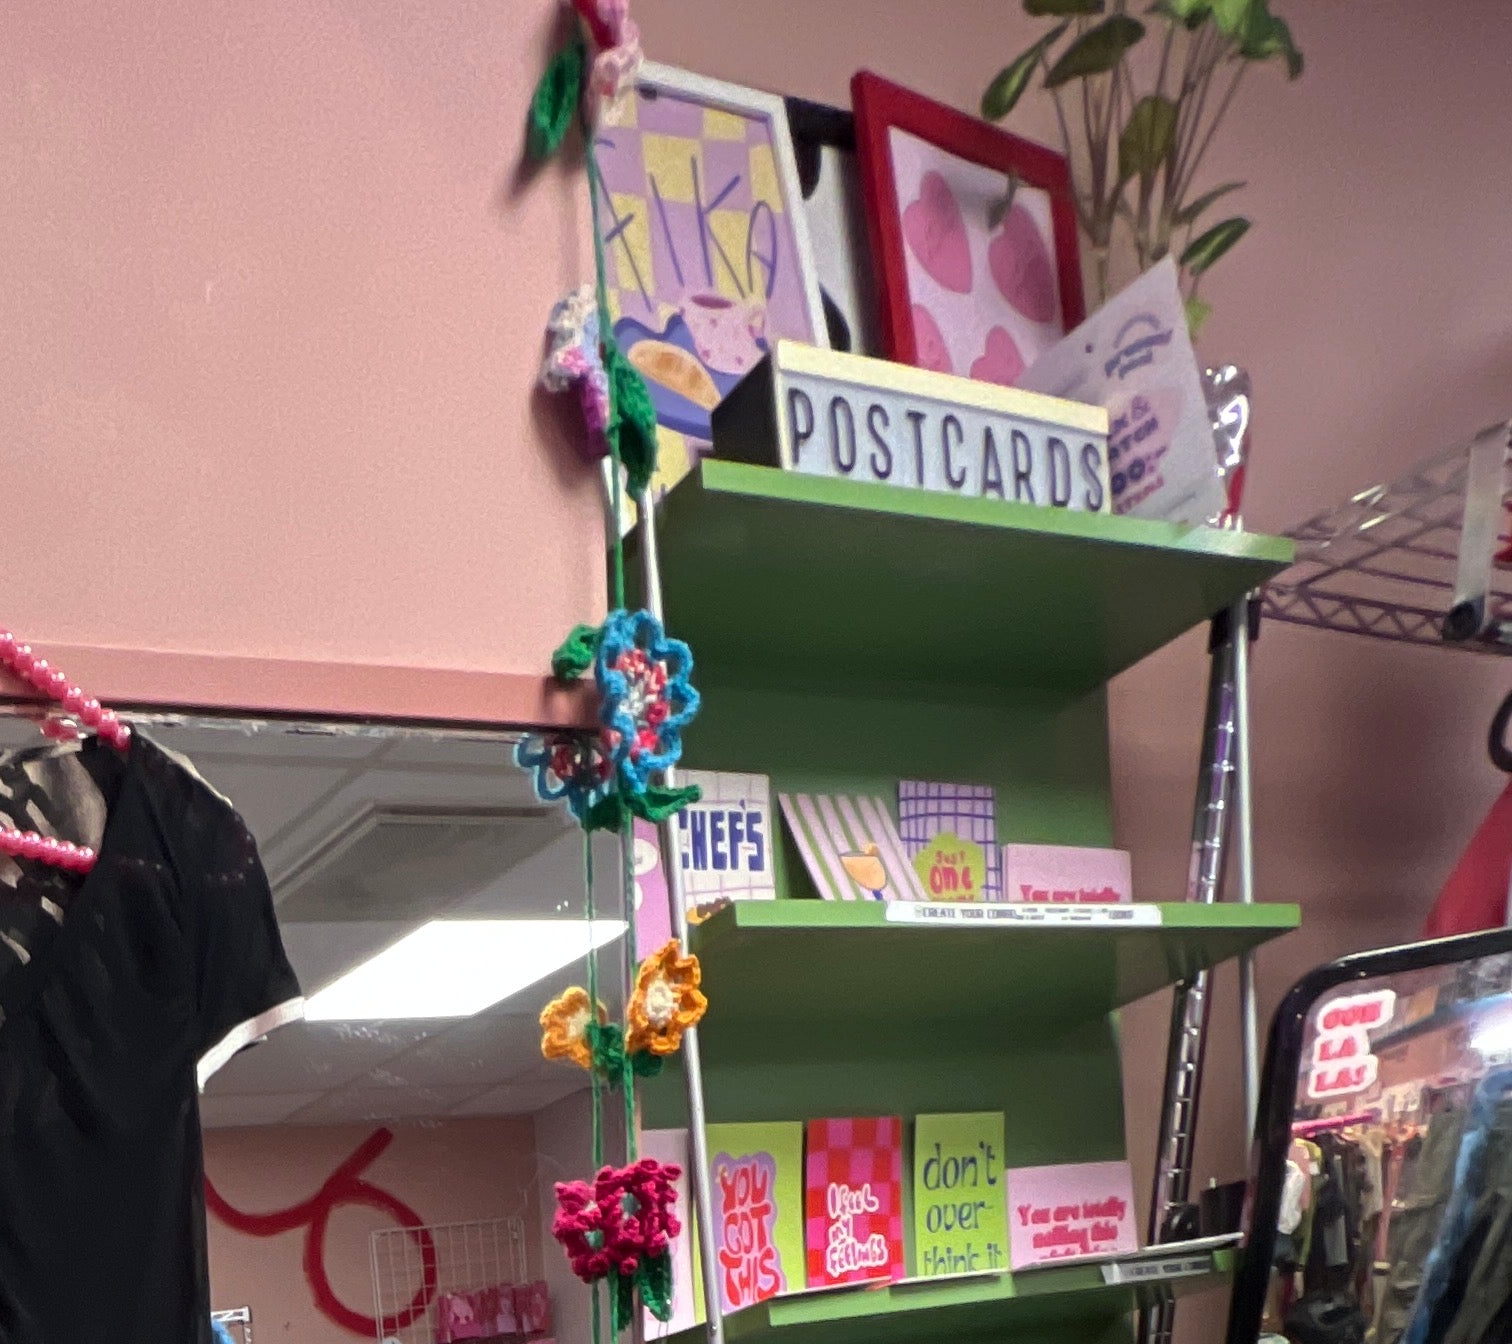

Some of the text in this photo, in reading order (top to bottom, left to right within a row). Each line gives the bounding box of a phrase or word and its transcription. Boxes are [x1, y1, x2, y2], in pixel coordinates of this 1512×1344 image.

[788, 387, 1103, 512] POSTCARDS
[1318, 1036, 1358, 1062] LA
[719, 1162, 769, 1216] YOU
[923, 1142, 997, 1190] don't
[724, 1202, 772, 1255] GOT
[718, 1246, 781, 1307] THIS
[924, 1243, 981, 1275] think
